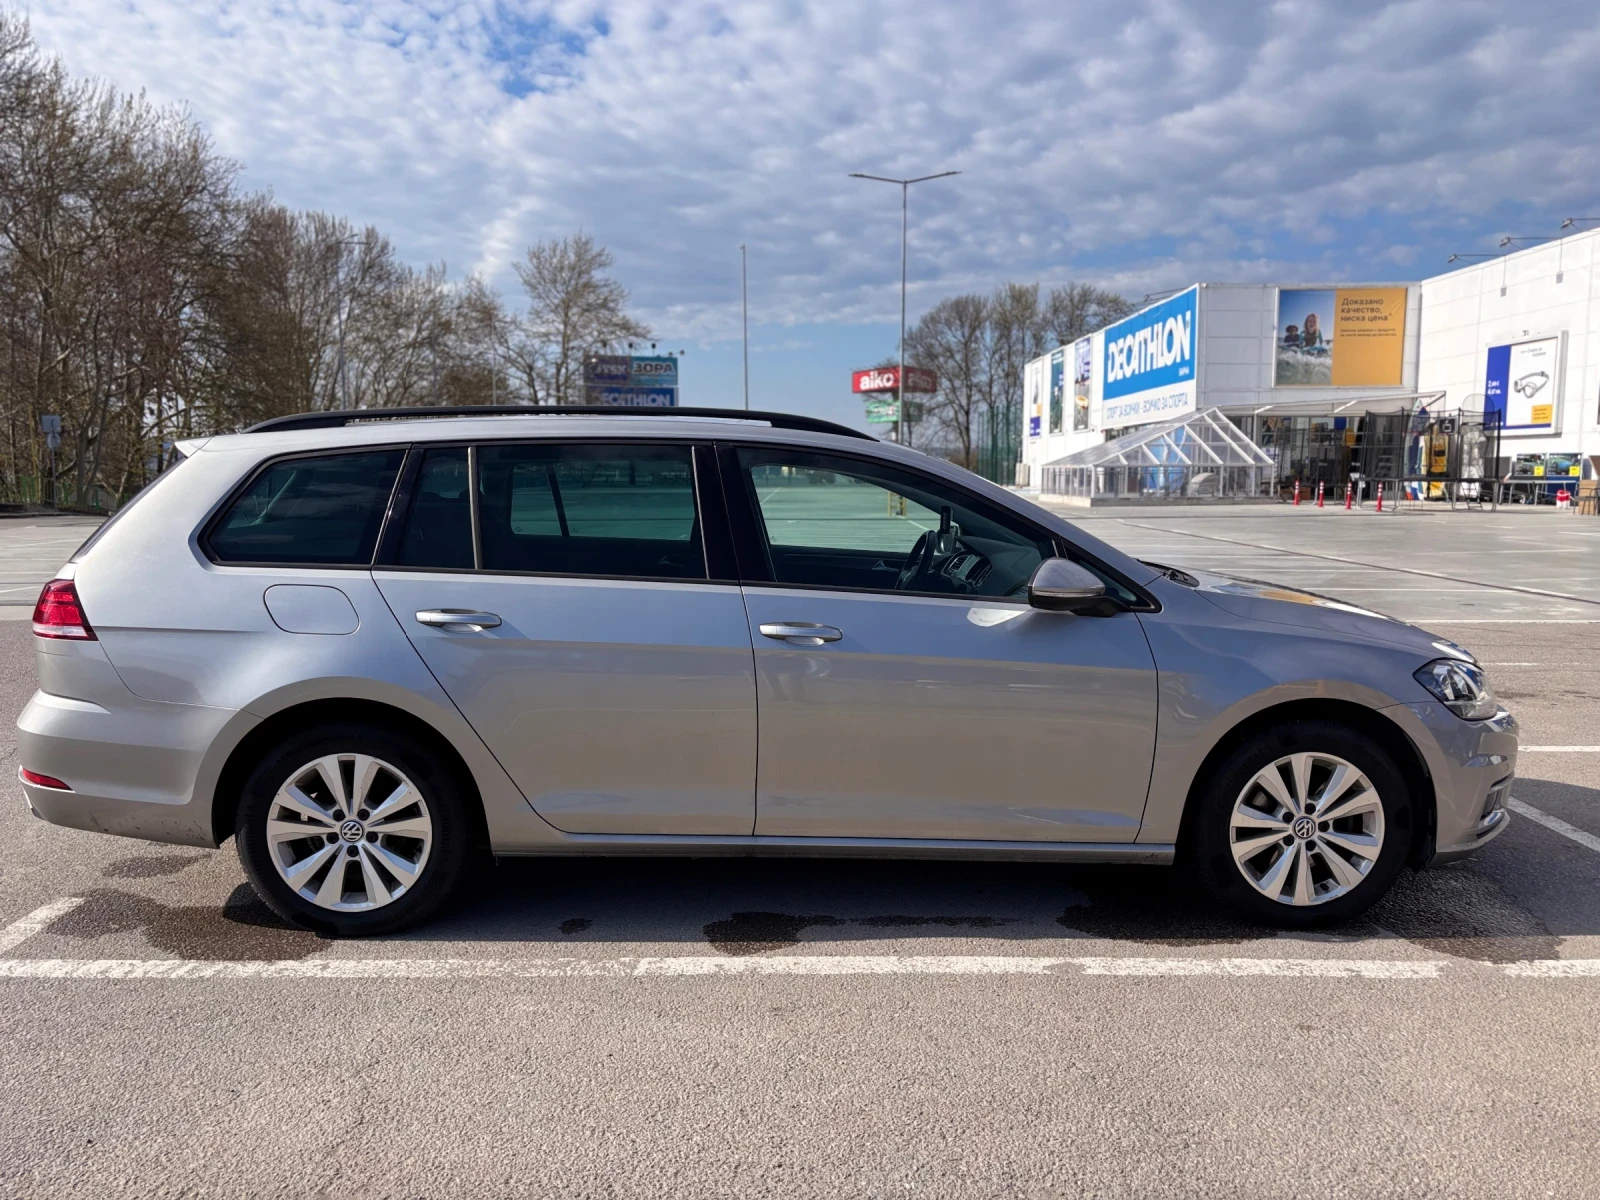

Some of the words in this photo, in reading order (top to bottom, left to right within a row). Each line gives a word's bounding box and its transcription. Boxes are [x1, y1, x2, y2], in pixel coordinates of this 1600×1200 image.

[1341, 297, 1384, 306] Доказано
[1107, 310, 1191, 383] DECATHLON
[633, 361, 675, 374] ЗОРА
[860, 371, 894, 390] aiko
